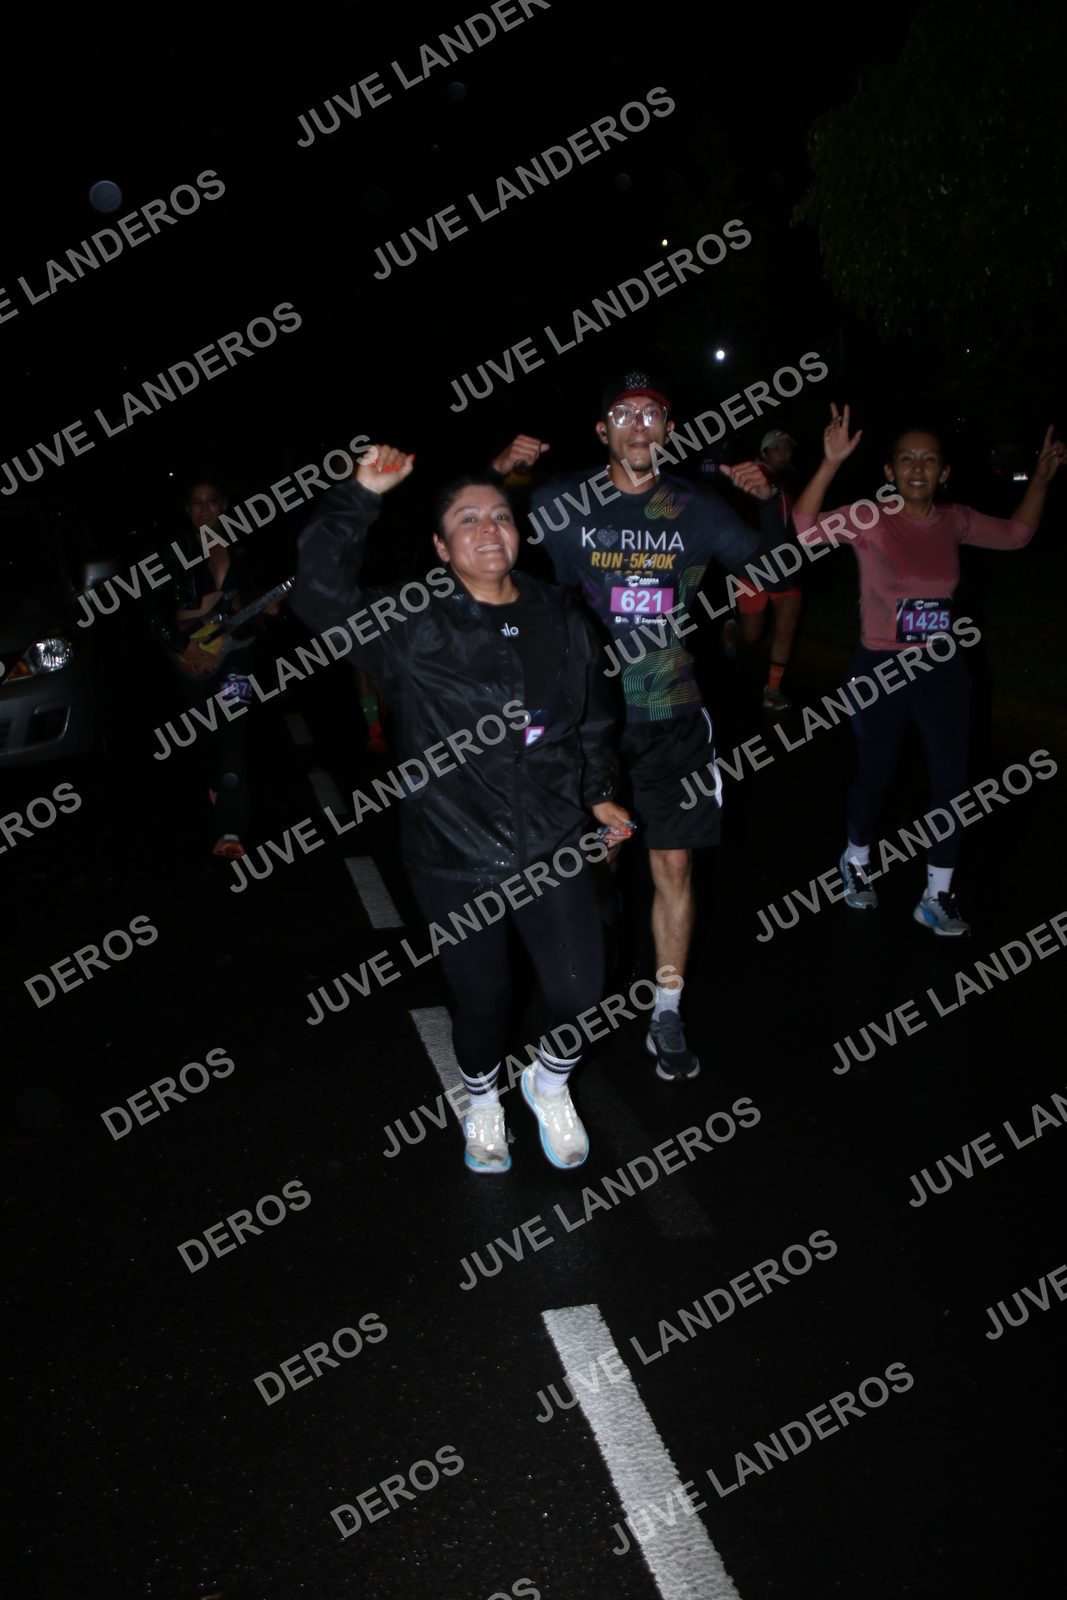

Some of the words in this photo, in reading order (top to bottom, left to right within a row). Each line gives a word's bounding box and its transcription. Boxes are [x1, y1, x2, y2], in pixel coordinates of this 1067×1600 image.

[581, 526, 684, 552] KRIMA
[621, 589, 663, 612] 621
[905, 611, 950, 631] 1425
